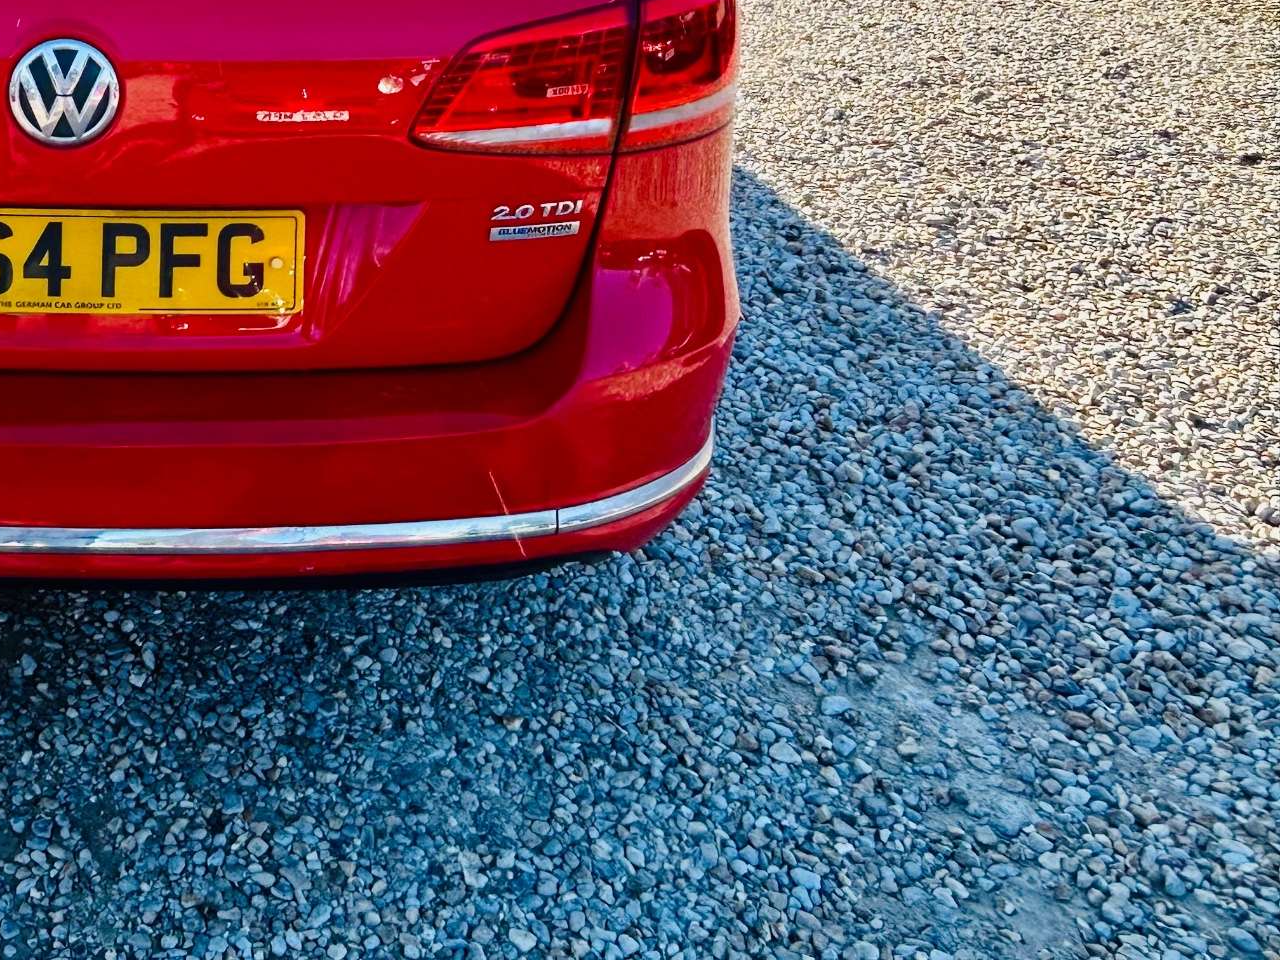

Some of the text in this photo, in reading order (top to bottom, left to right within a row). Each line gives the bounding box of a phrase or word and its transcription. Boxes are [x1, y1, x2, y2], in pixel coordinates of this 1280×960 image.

[17, 45, 111, 139] VW
[490, 200, 584, 221] 2.0 TDI
[498, 223, 573, 236] BLUEMOTION
[101, 222, 265, 299] PFG
[54, 301, 73, 309] CAR
